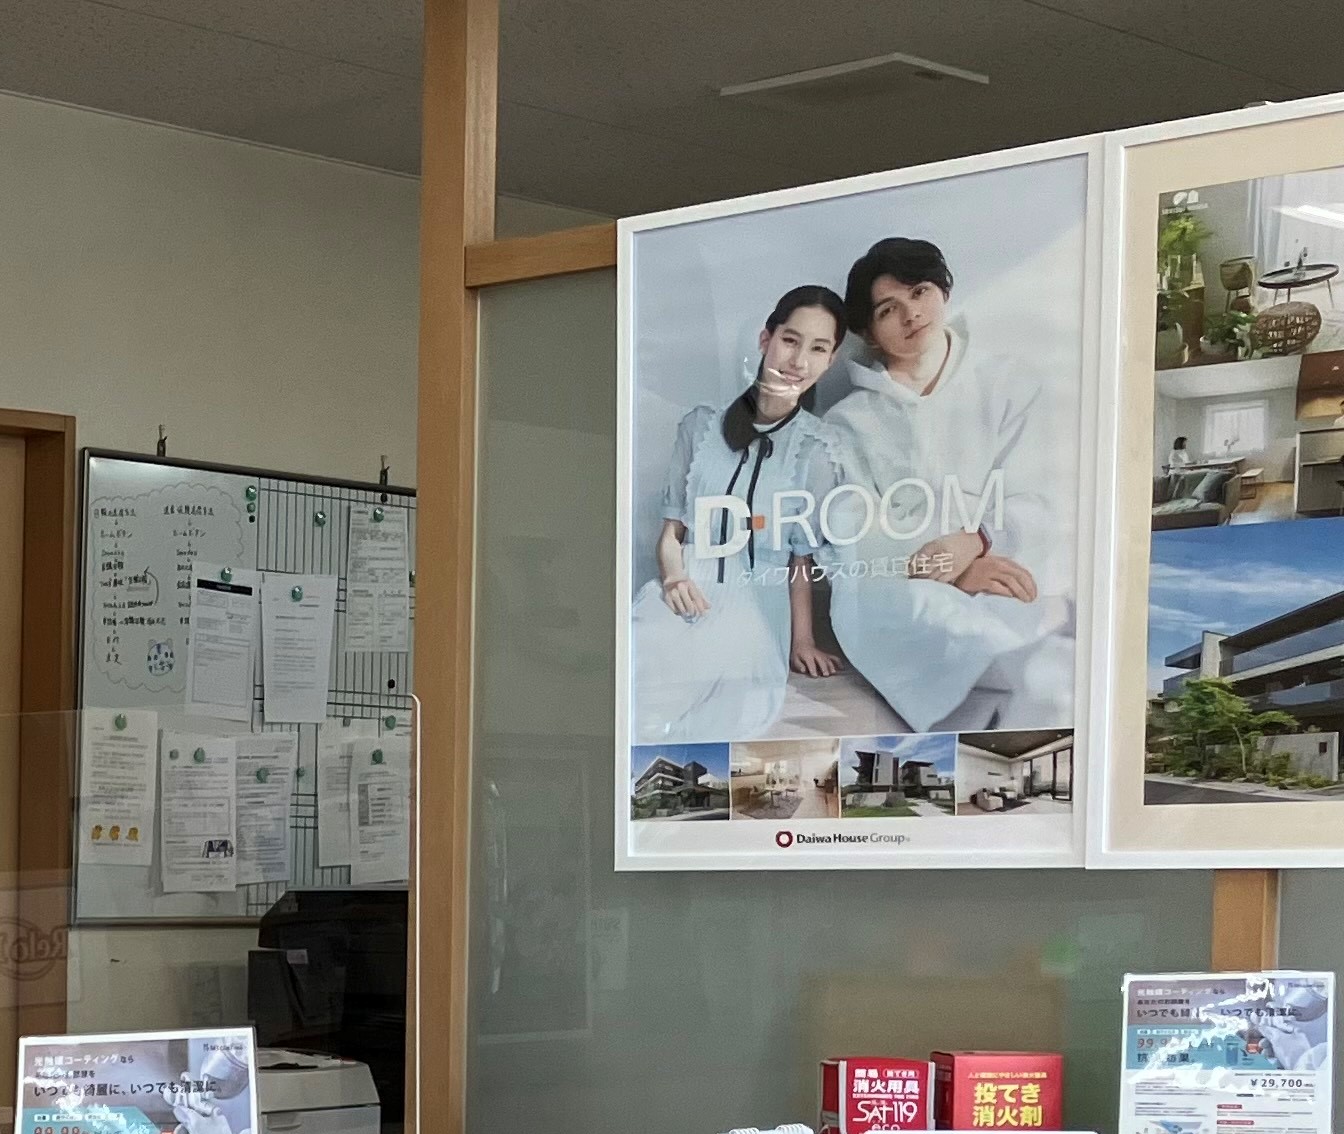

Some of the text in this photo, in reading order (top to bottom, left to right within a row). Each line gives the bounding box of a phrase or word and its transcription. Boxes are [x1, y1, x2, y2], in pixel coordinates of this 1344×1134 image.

[796, 831, 906, 846] Daiwa House Group
[853, 1079, 920, 1094] 消火用具
[974, 1082, 1041, 1104] 投てき
[972, 1105, 1043, 1127] 消火剤
